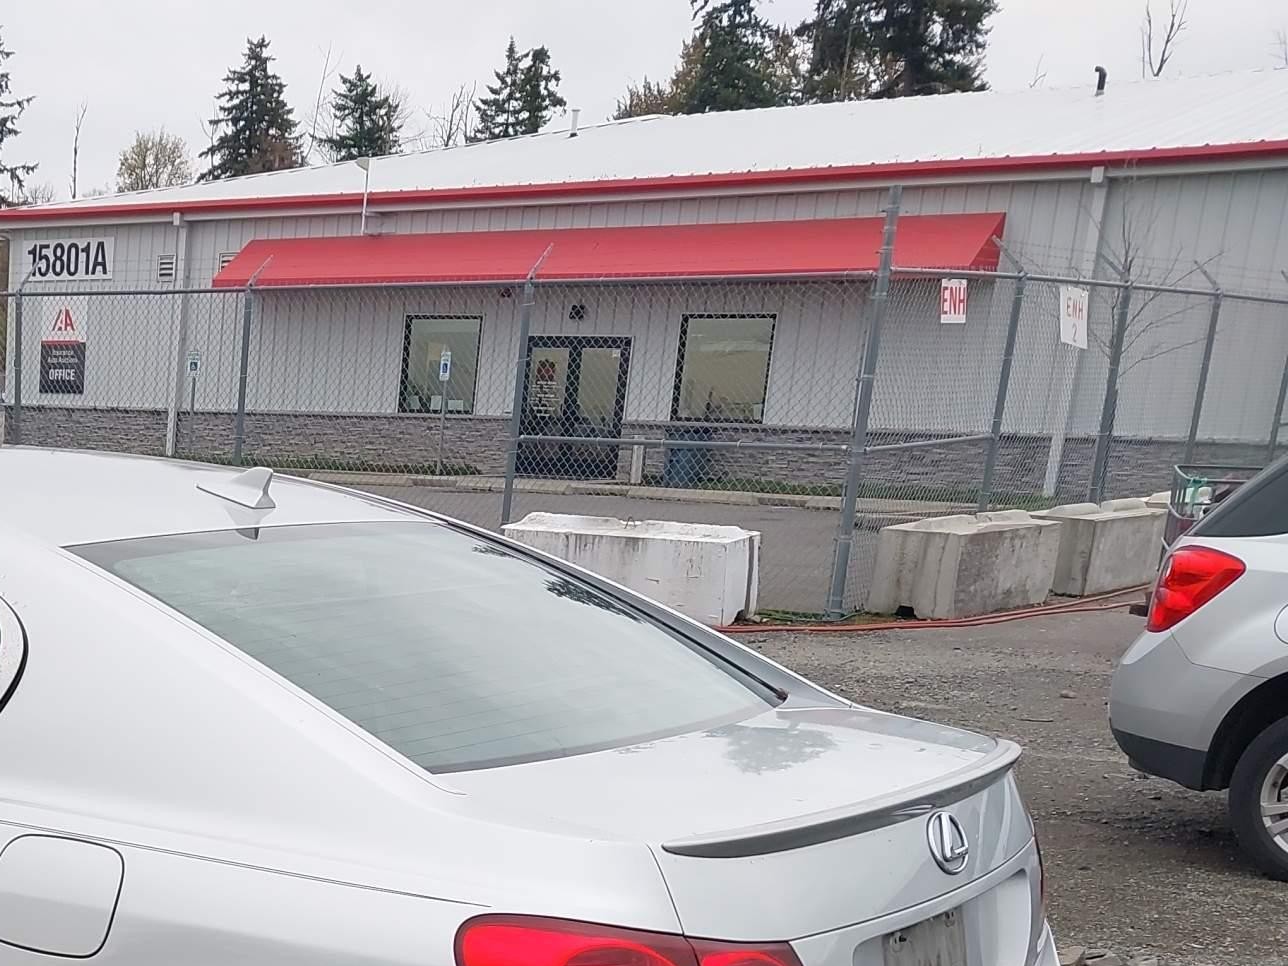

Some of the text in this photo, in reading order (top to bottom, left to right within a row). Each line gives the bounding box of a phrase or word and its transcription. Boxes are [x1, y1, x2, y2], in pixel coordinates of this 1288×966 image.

[28, 241, 108, 277] 15801A
[942, 285, 966, 315] ENH
[1066, 296, 1084, 321] ENH
[49, 368, 76, 380] OFFICE
